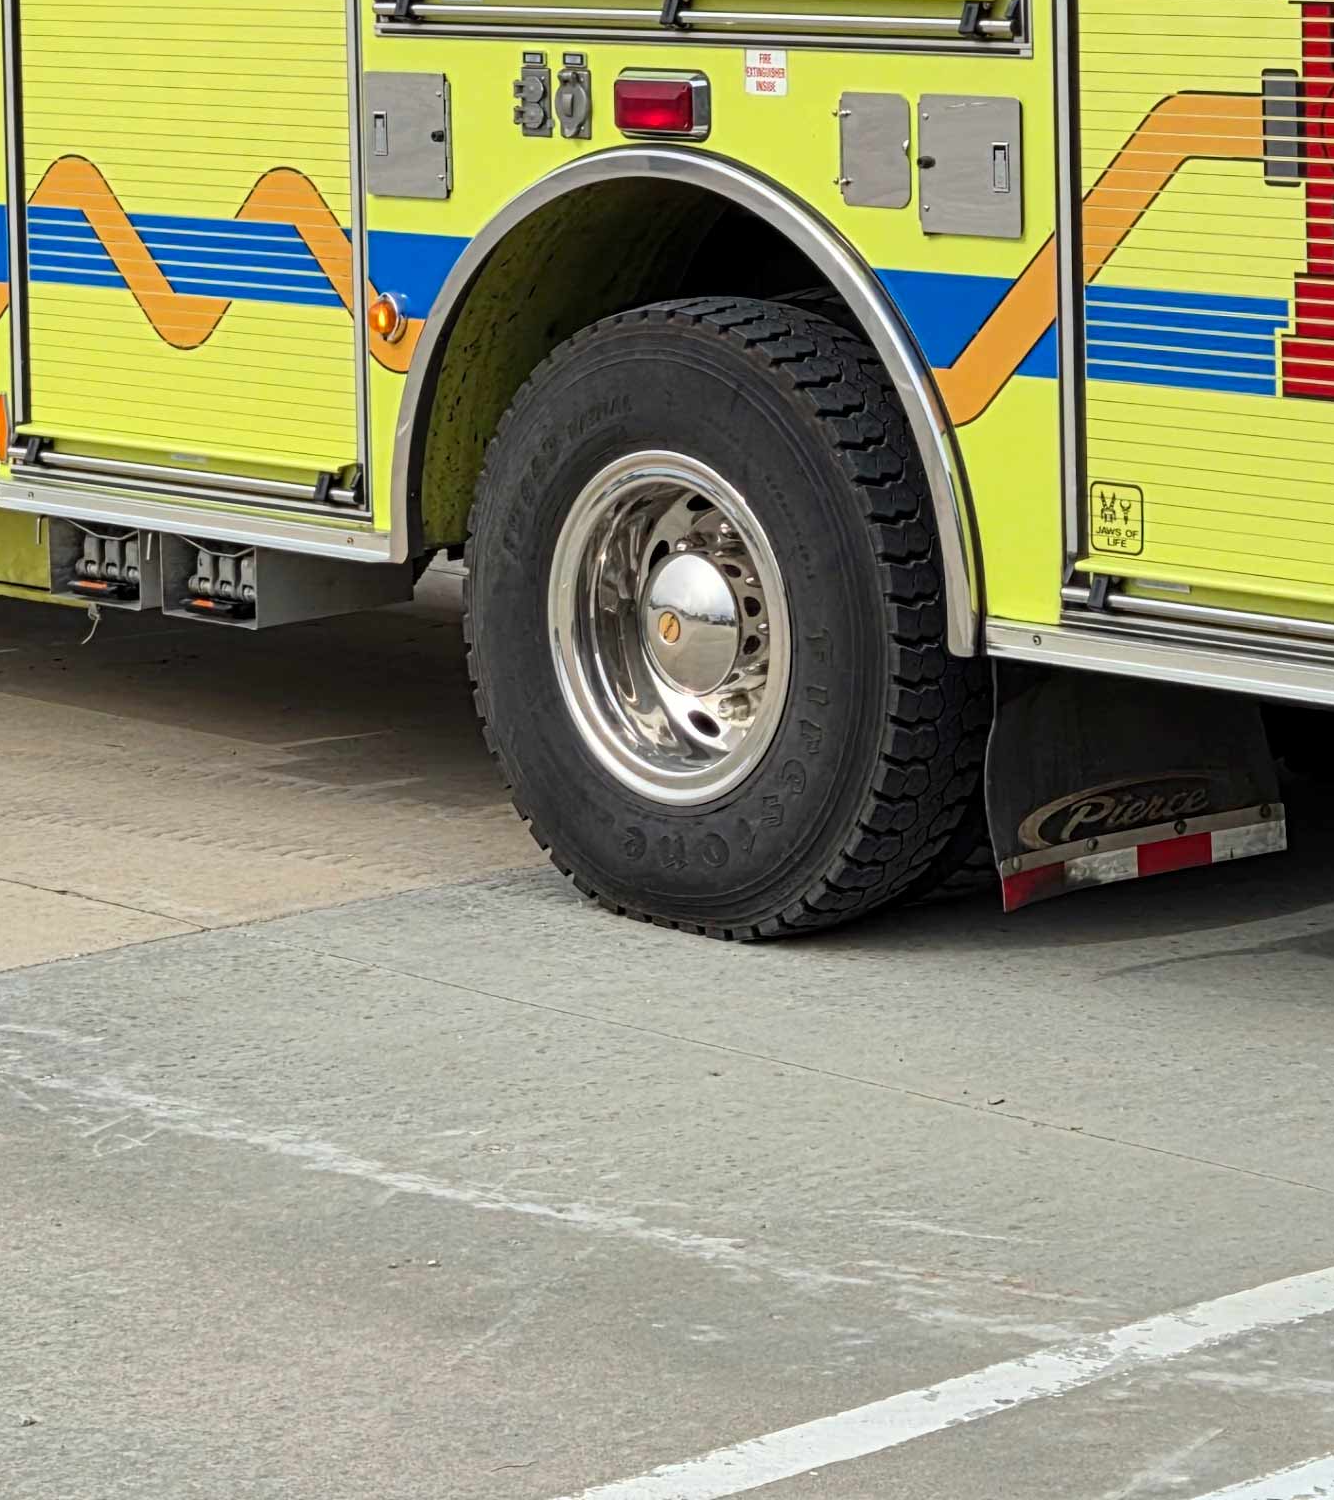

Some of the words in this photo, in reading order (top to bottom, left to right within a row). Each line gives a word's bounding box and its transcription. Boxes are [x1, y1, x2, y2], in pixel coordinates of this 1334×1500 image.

[759, 53, 772, 64] FIRE
[746, 67, 785, 78] EXTINGUISHER
[756, 81, 777, 92] INSIDE
[1095, 525, 1122, 537] JAWS
[1125, 529, 1139, 538] OF
[1107, 537, 1127, 548] LIFE
[1060, 787, 1210, 842] Pierce
